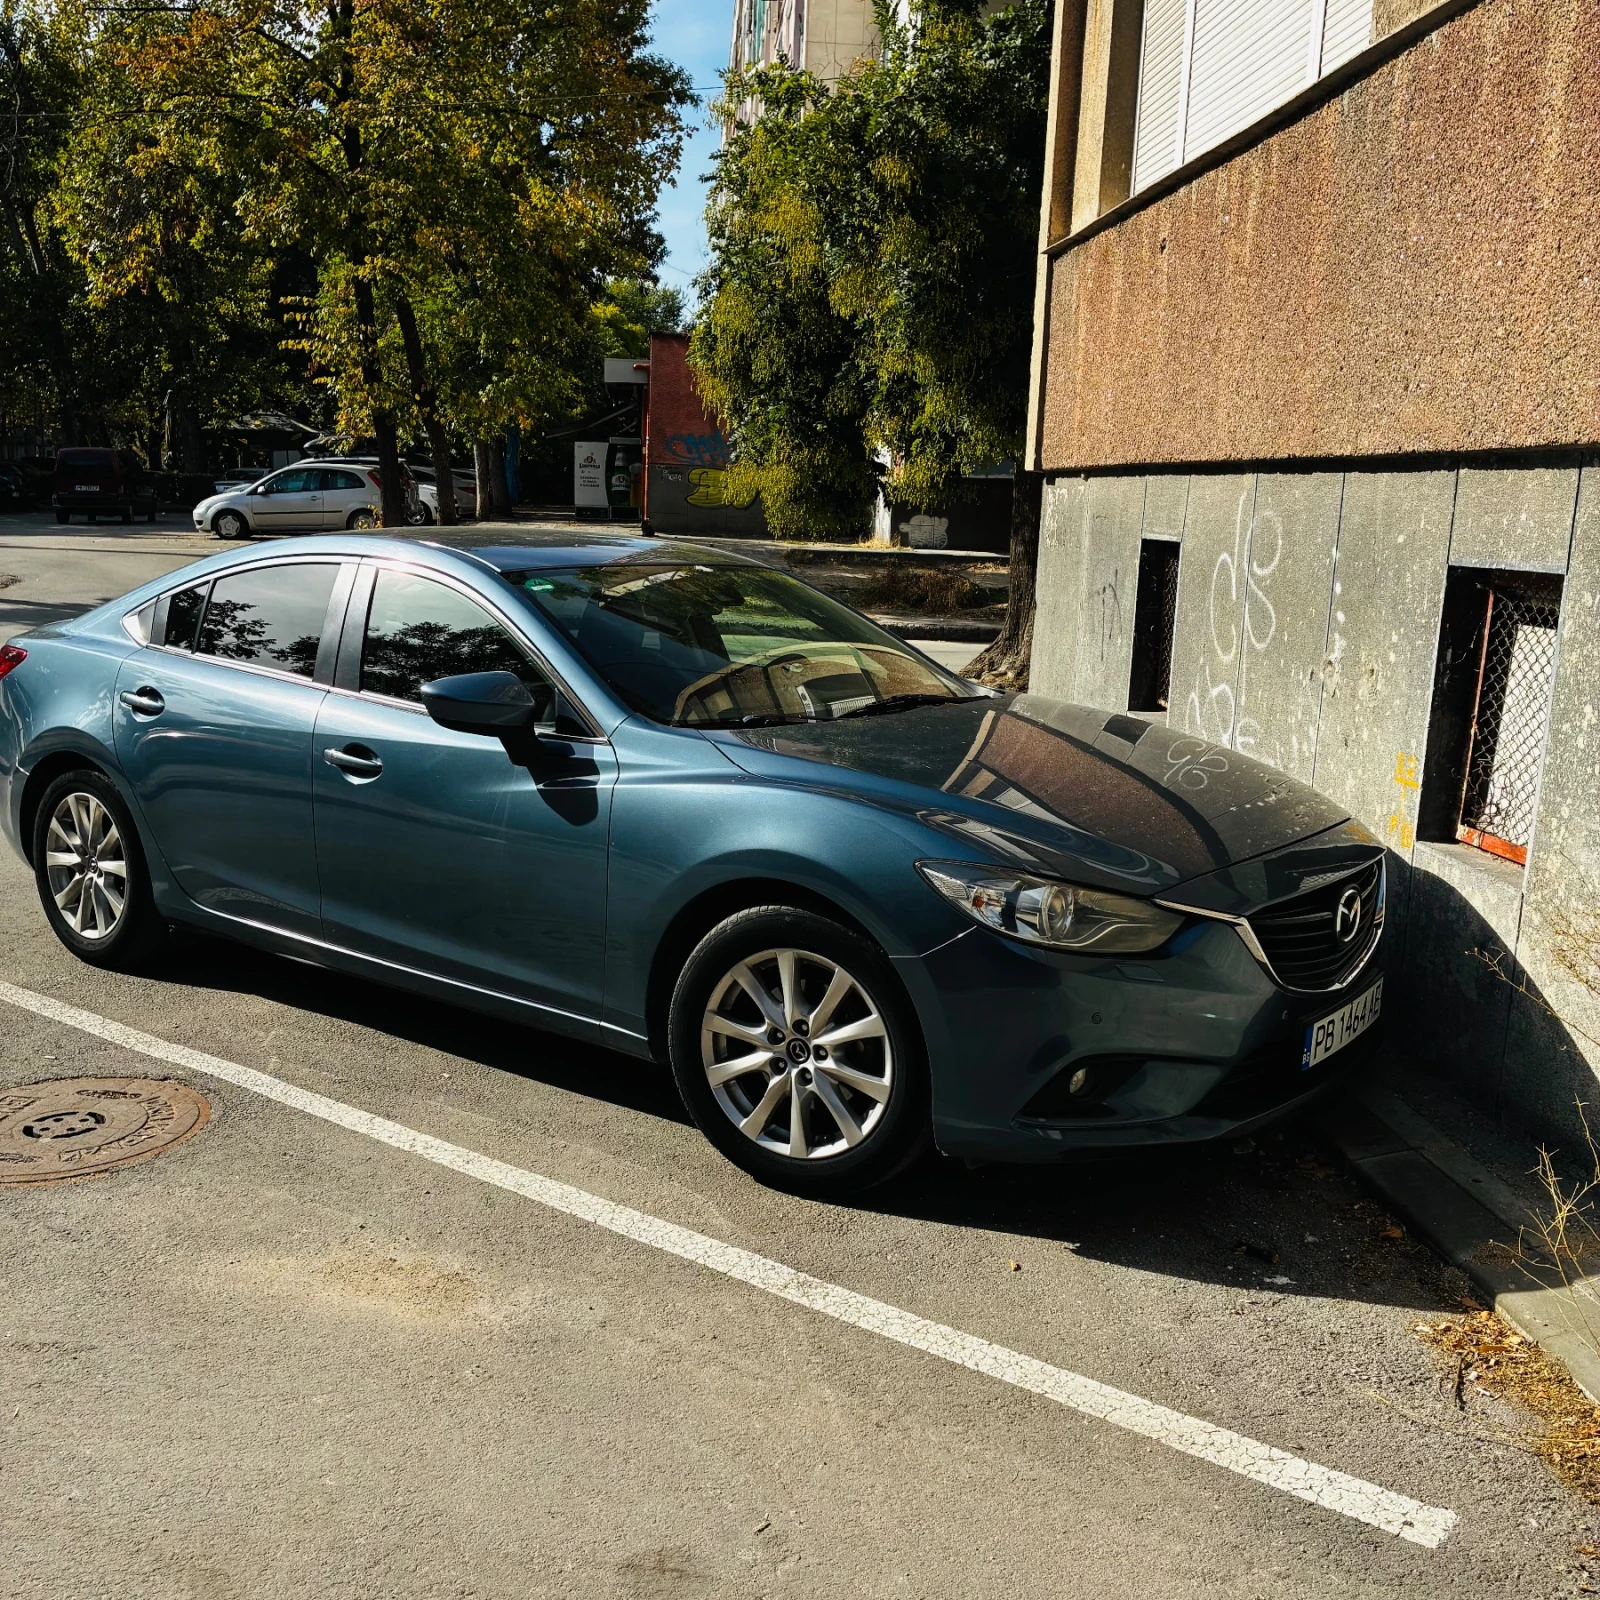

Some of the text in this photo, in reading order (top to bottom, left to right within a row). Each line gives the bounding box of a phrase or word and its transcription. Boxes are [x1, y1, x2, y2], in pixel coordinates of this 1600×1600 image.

[1314, 984, 1382, 1060] PB 1464 AE
